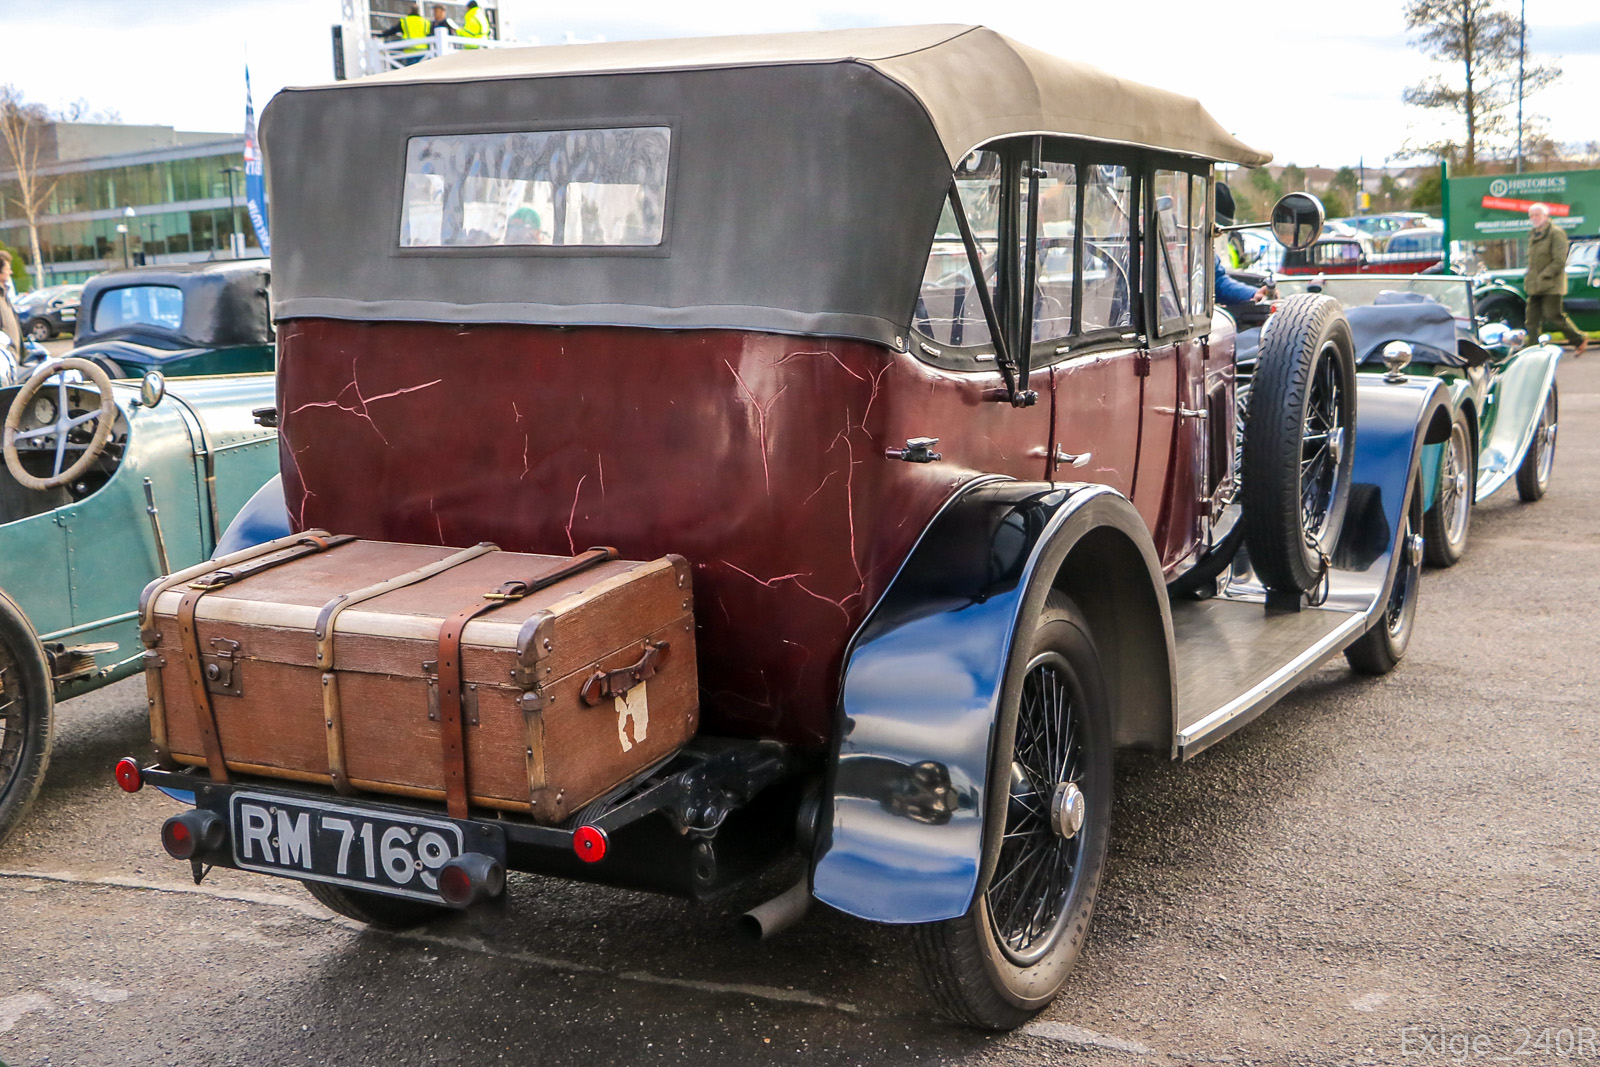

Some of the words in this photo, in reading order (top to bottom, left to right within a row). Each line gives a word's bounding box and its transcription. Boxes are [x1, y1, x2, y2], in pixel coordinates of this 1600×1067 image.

[1508, 176, 1566, 189] HISTORICS
[240, 804, 312, 869] RM
[320, 816, 452, 890] 7169
